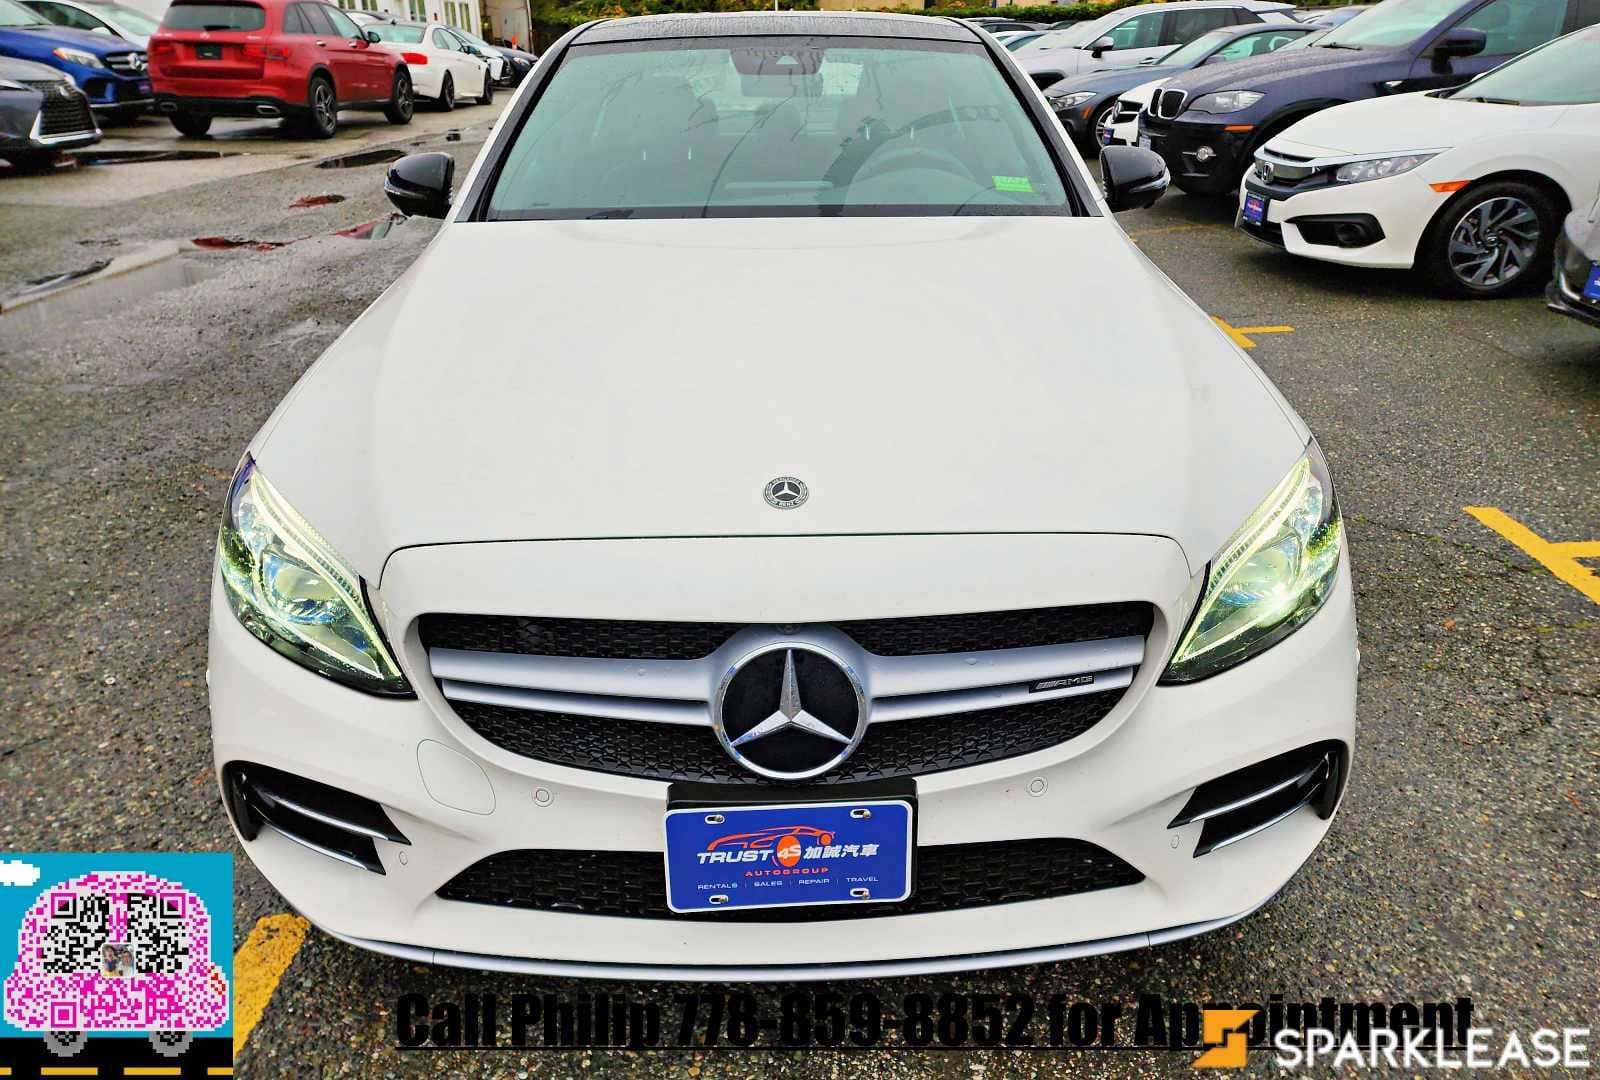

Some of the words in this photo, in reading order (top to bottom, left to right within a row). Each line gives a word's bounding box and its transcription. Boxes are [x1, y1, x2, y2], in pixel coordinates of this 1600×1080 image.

[1055, 675, 1093, 687] AMG
[697, 849, 774, 864] TRUST
[777, 844, 801, 860] 4S
[803, 843, 880, 860] 加誠汽車
[744, 866, 829, 878] AUTOGROUP
[697, 882, 738, 890] RENTALS
